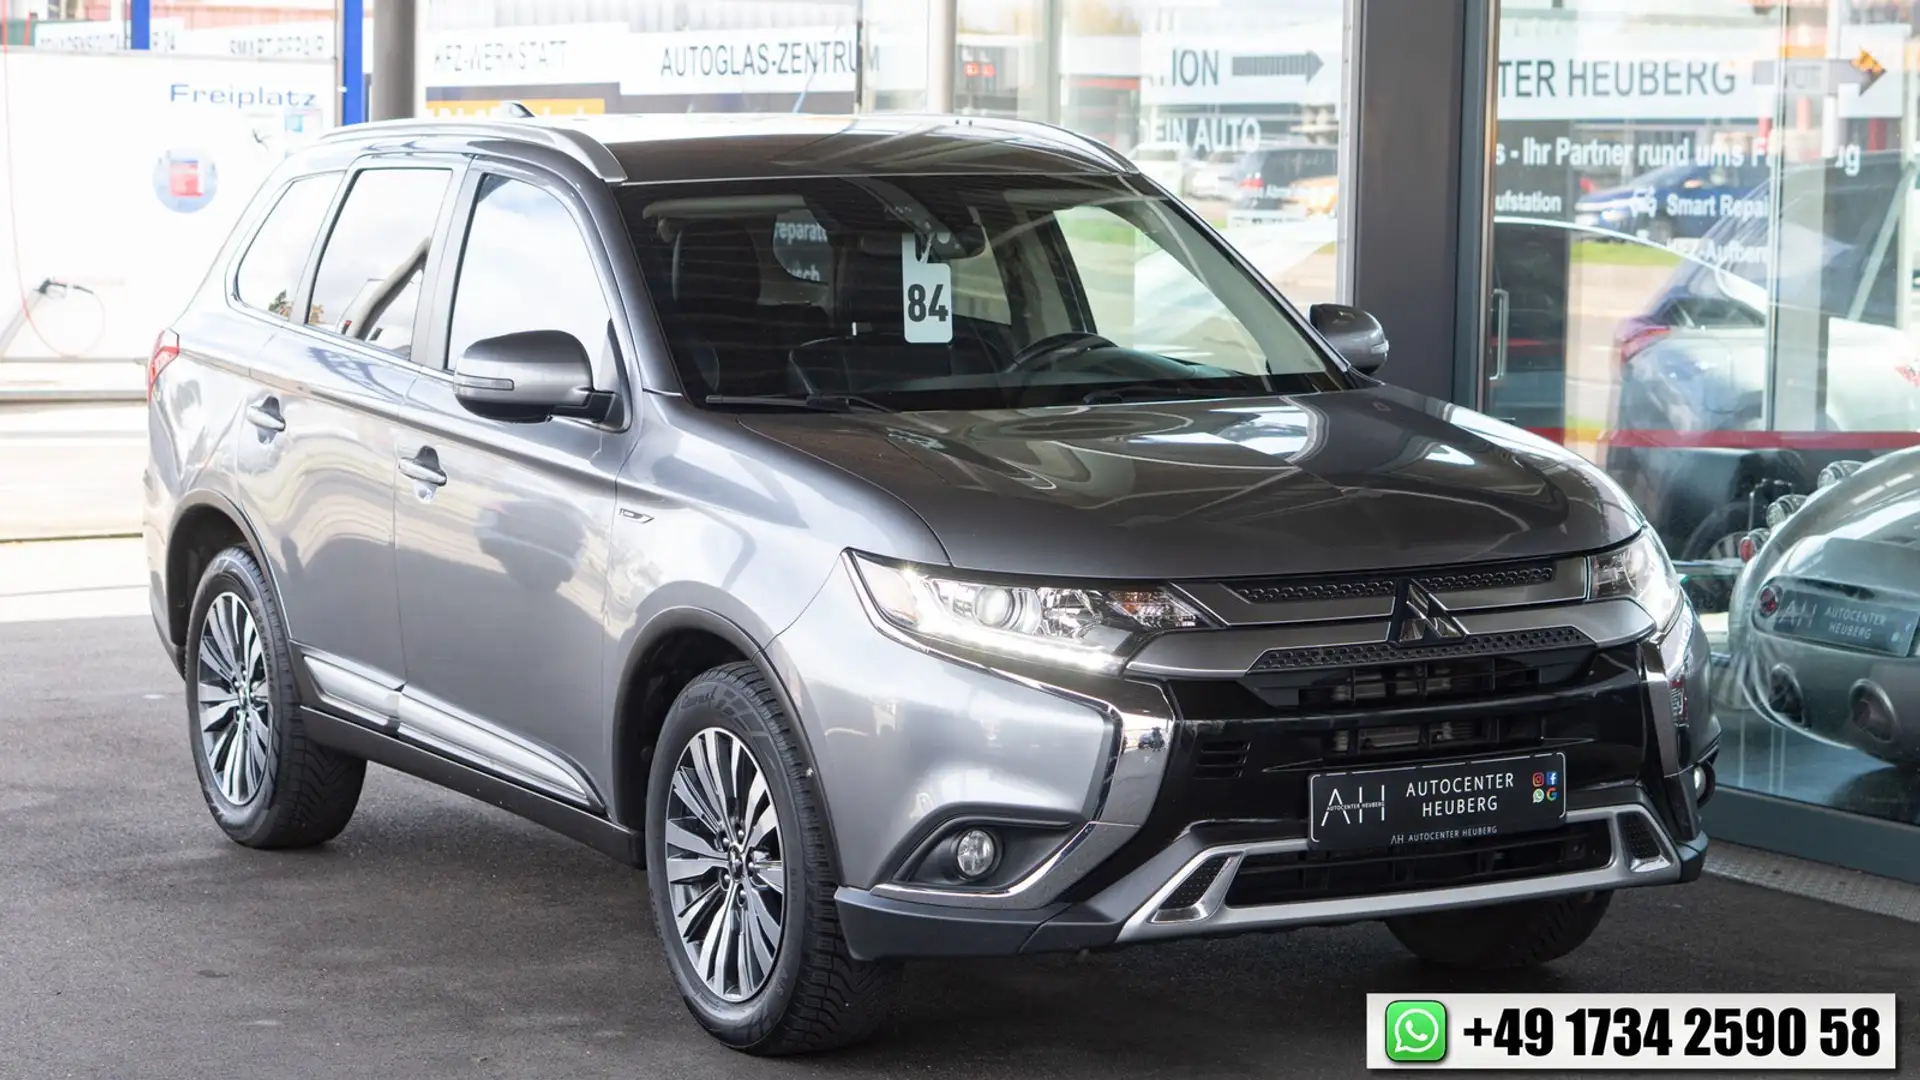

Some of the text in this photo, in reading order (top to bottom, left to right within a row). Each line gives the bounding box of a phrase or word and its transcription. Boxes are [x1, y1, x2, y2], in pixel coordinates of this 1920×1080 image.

[661, 39, 880, 76] AUTOGLAS-ZENTRUM
[1568, 59, 1736, 97] HEUBERG
[169, 83, 317, 109] Freiplatz
[1192, 116, 1261, 152] AUTO
[1523, 137, 1552, 166] Ihr
[1555, 137, 1635, 166] Partner
[1638, 137, 1690, 167] rund
[1695, 146, 1745, 168] ums
[1666, 193, 1770, 222] Smart Repai
[907, 283, 949, 323] 84
[1824, 606, 1887, 627] AUTOCENTER
[1828, 621, 1872, 640] HEUBERG
[1406, 772, 1514, 798] AUTOCENTER
[1422, 795, 1498, 818] HEUBERG
[1408, 829, 1459, 842] AUTOCENTER
[1462, 825, 1498, 838] HEUBERG
